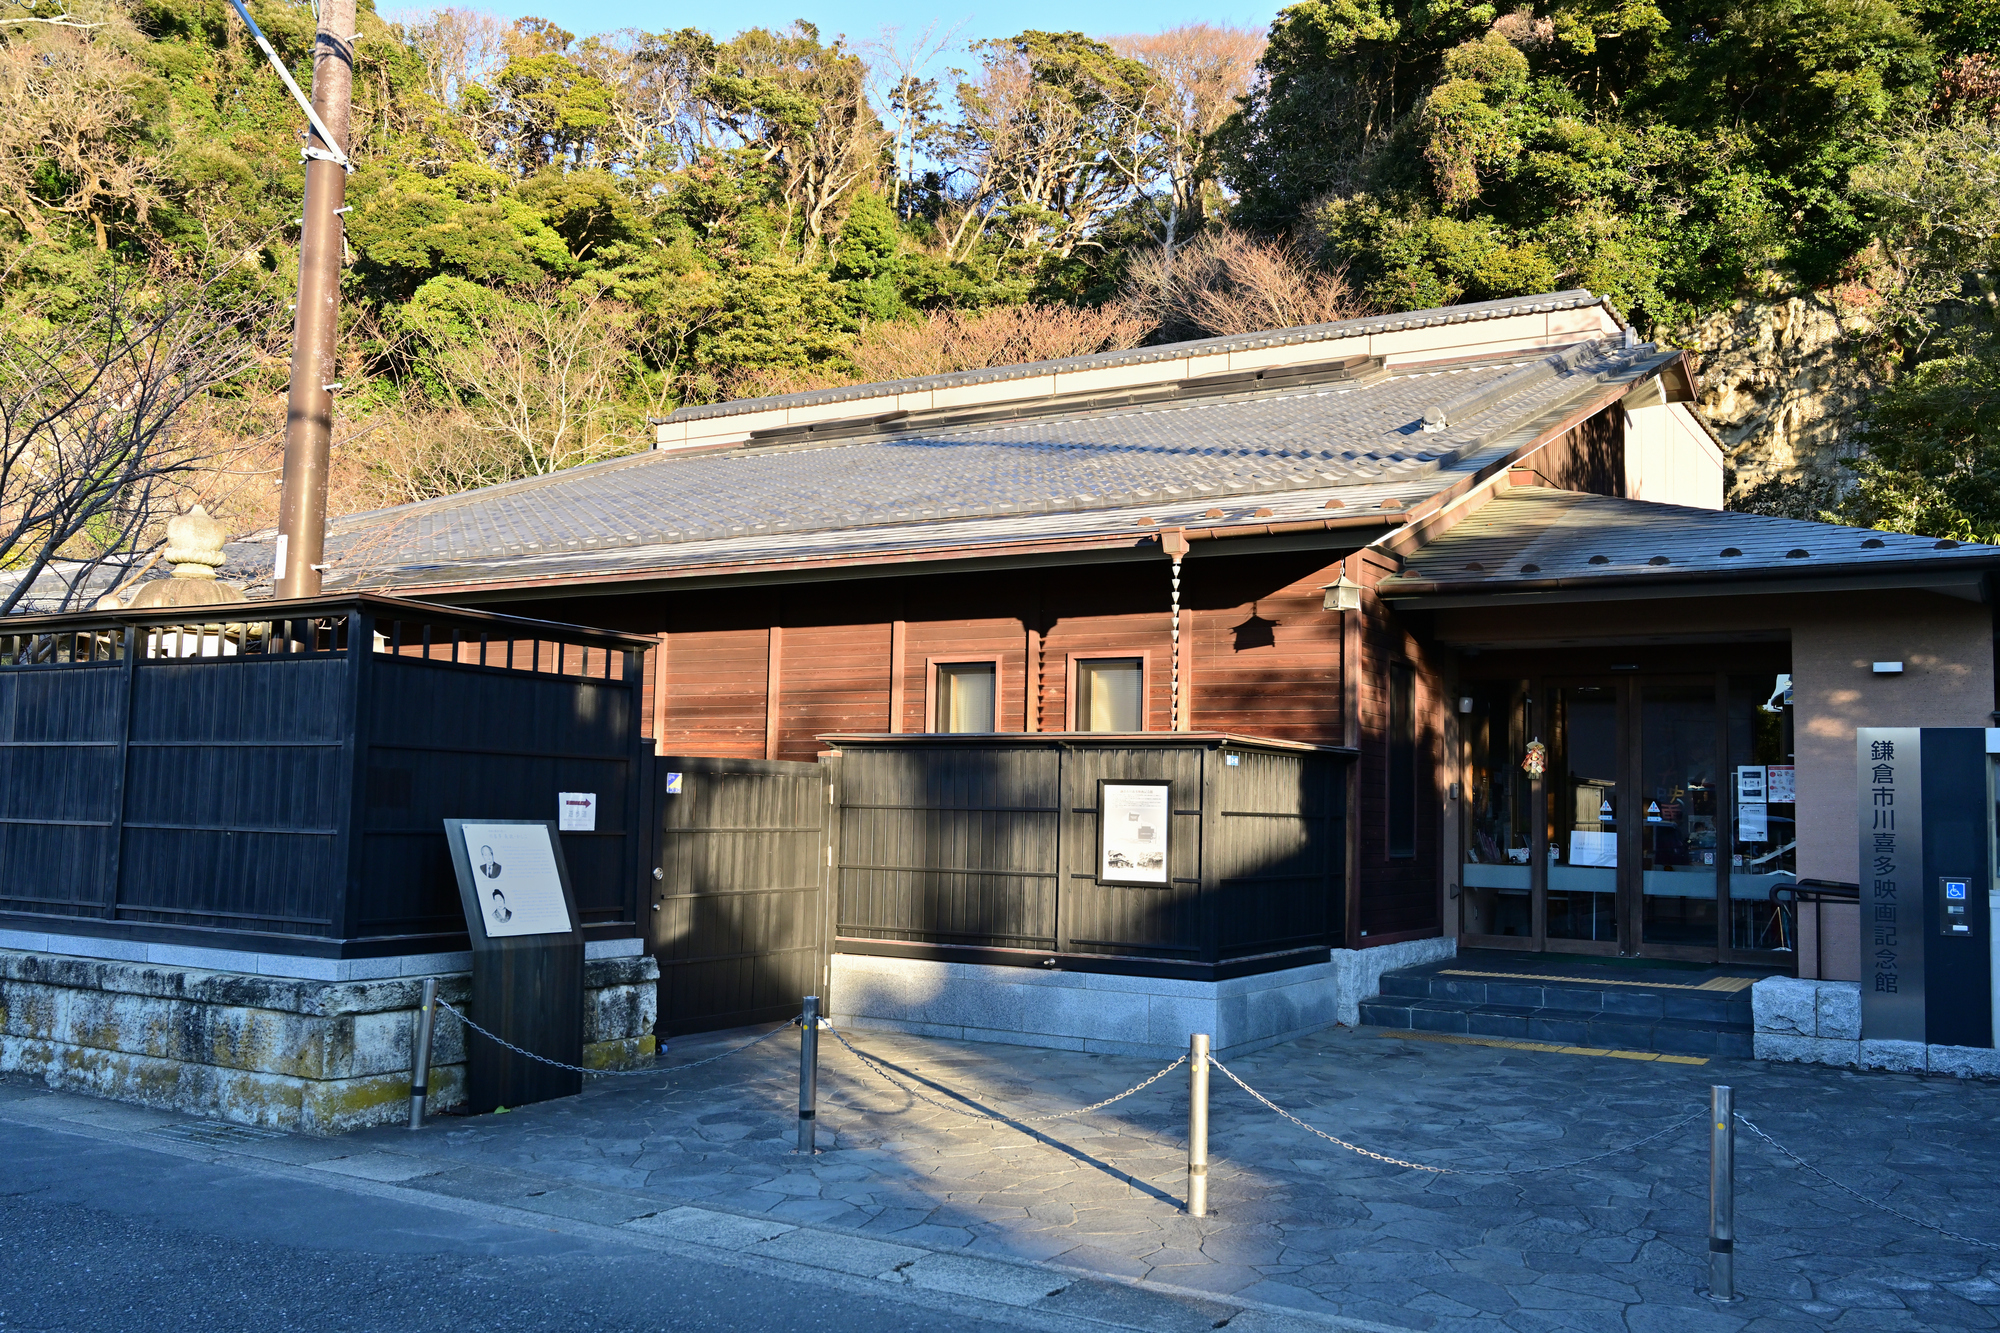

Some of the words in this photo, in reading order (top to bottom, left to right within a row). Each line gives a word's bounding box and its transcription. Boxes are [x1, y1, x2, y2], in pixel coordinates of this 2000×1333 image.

[1871, 740, 1898, 994] 鎌倉市川喜多映画記念館
